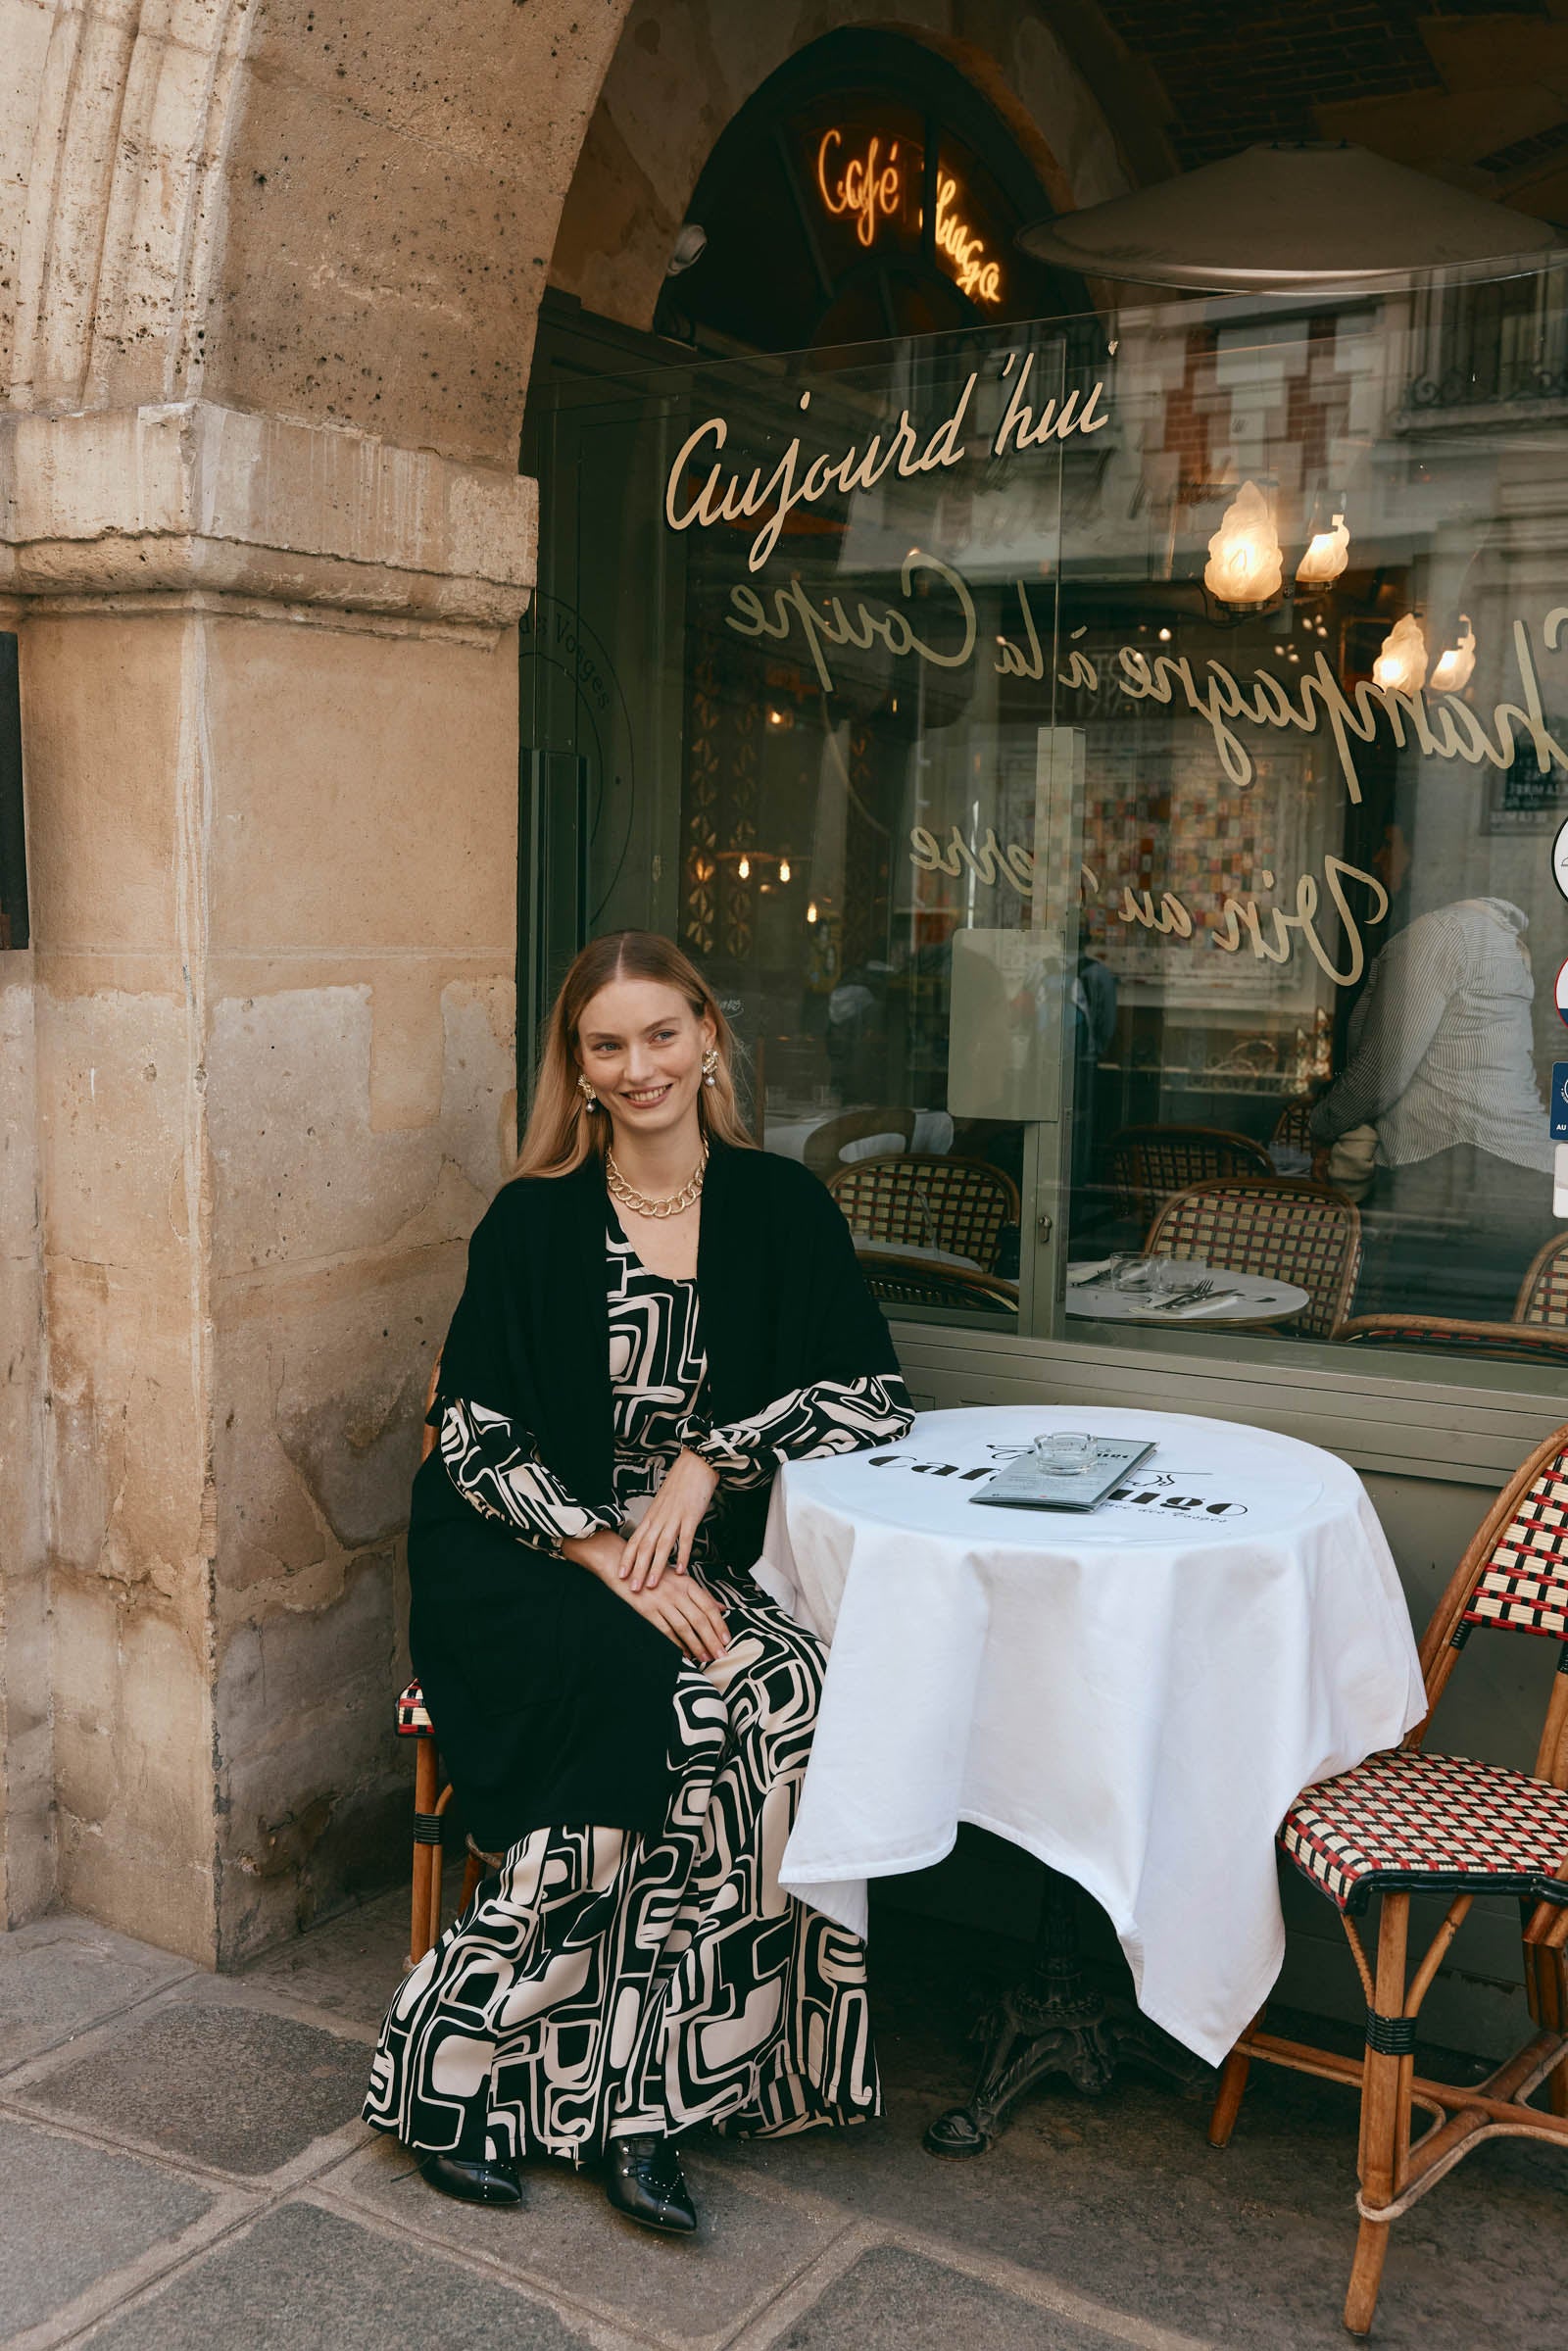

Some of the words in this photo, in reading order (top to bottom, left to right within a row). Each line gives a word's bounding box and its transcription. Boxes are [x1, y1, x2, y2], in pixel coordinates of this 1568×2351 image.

[818, 128, 900, 247] Café
[868, 1455, 1001, 1482] Caf
[1107, 1489, 1248, 1516] ugo
